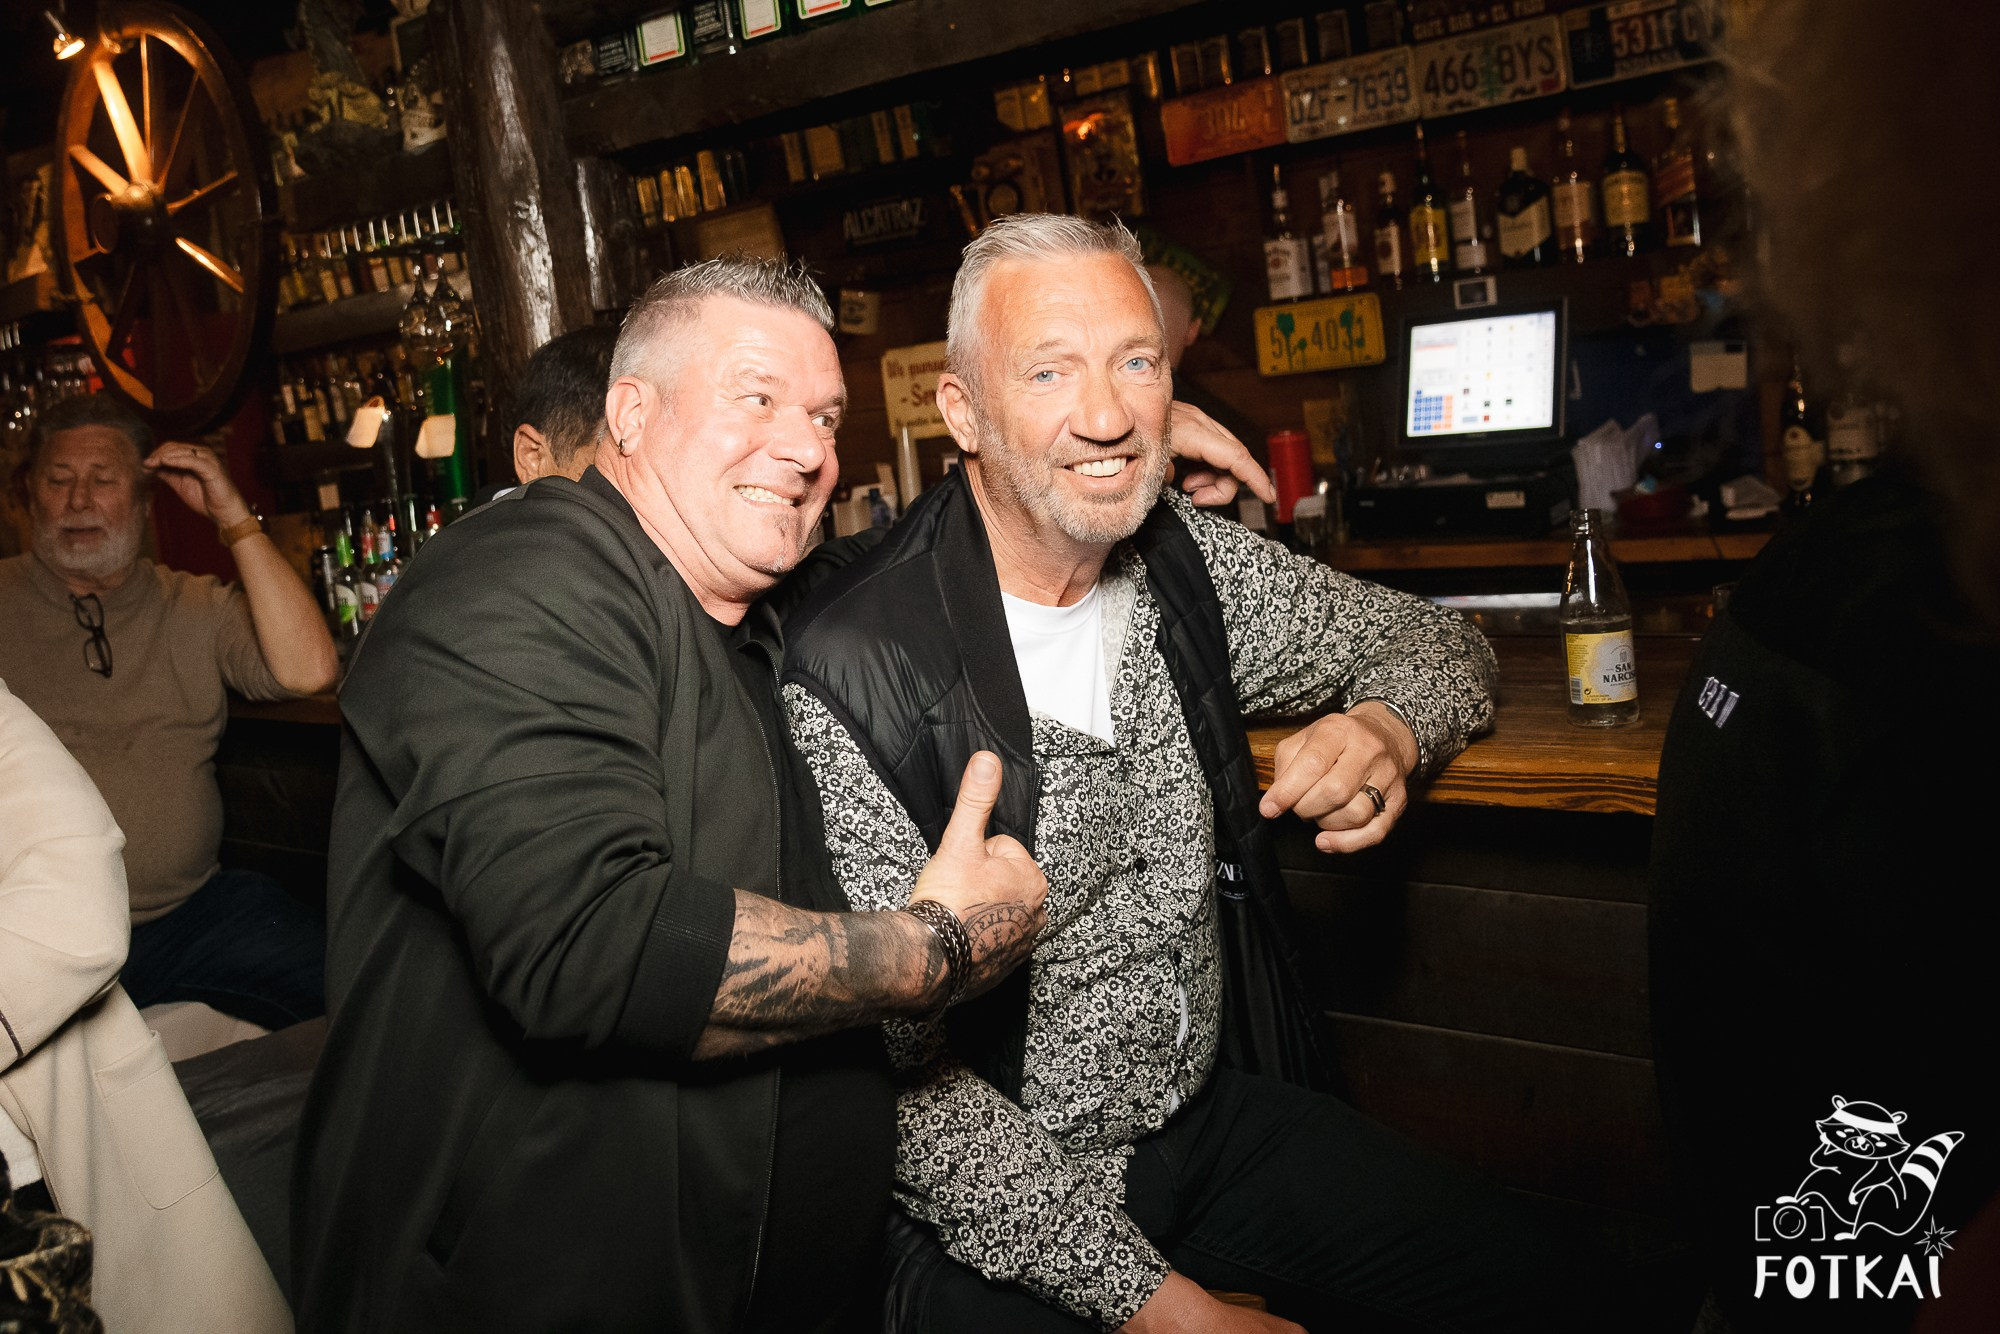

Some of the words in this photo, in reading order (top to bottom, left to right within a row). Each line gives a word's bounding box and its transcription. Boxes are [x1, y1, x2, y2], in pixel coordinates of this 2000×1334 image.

[1424, 52, 1479, 98] 466
[1496, 35, 1556, 85] BYS
[1615, 662, 1632, 673] SAN
